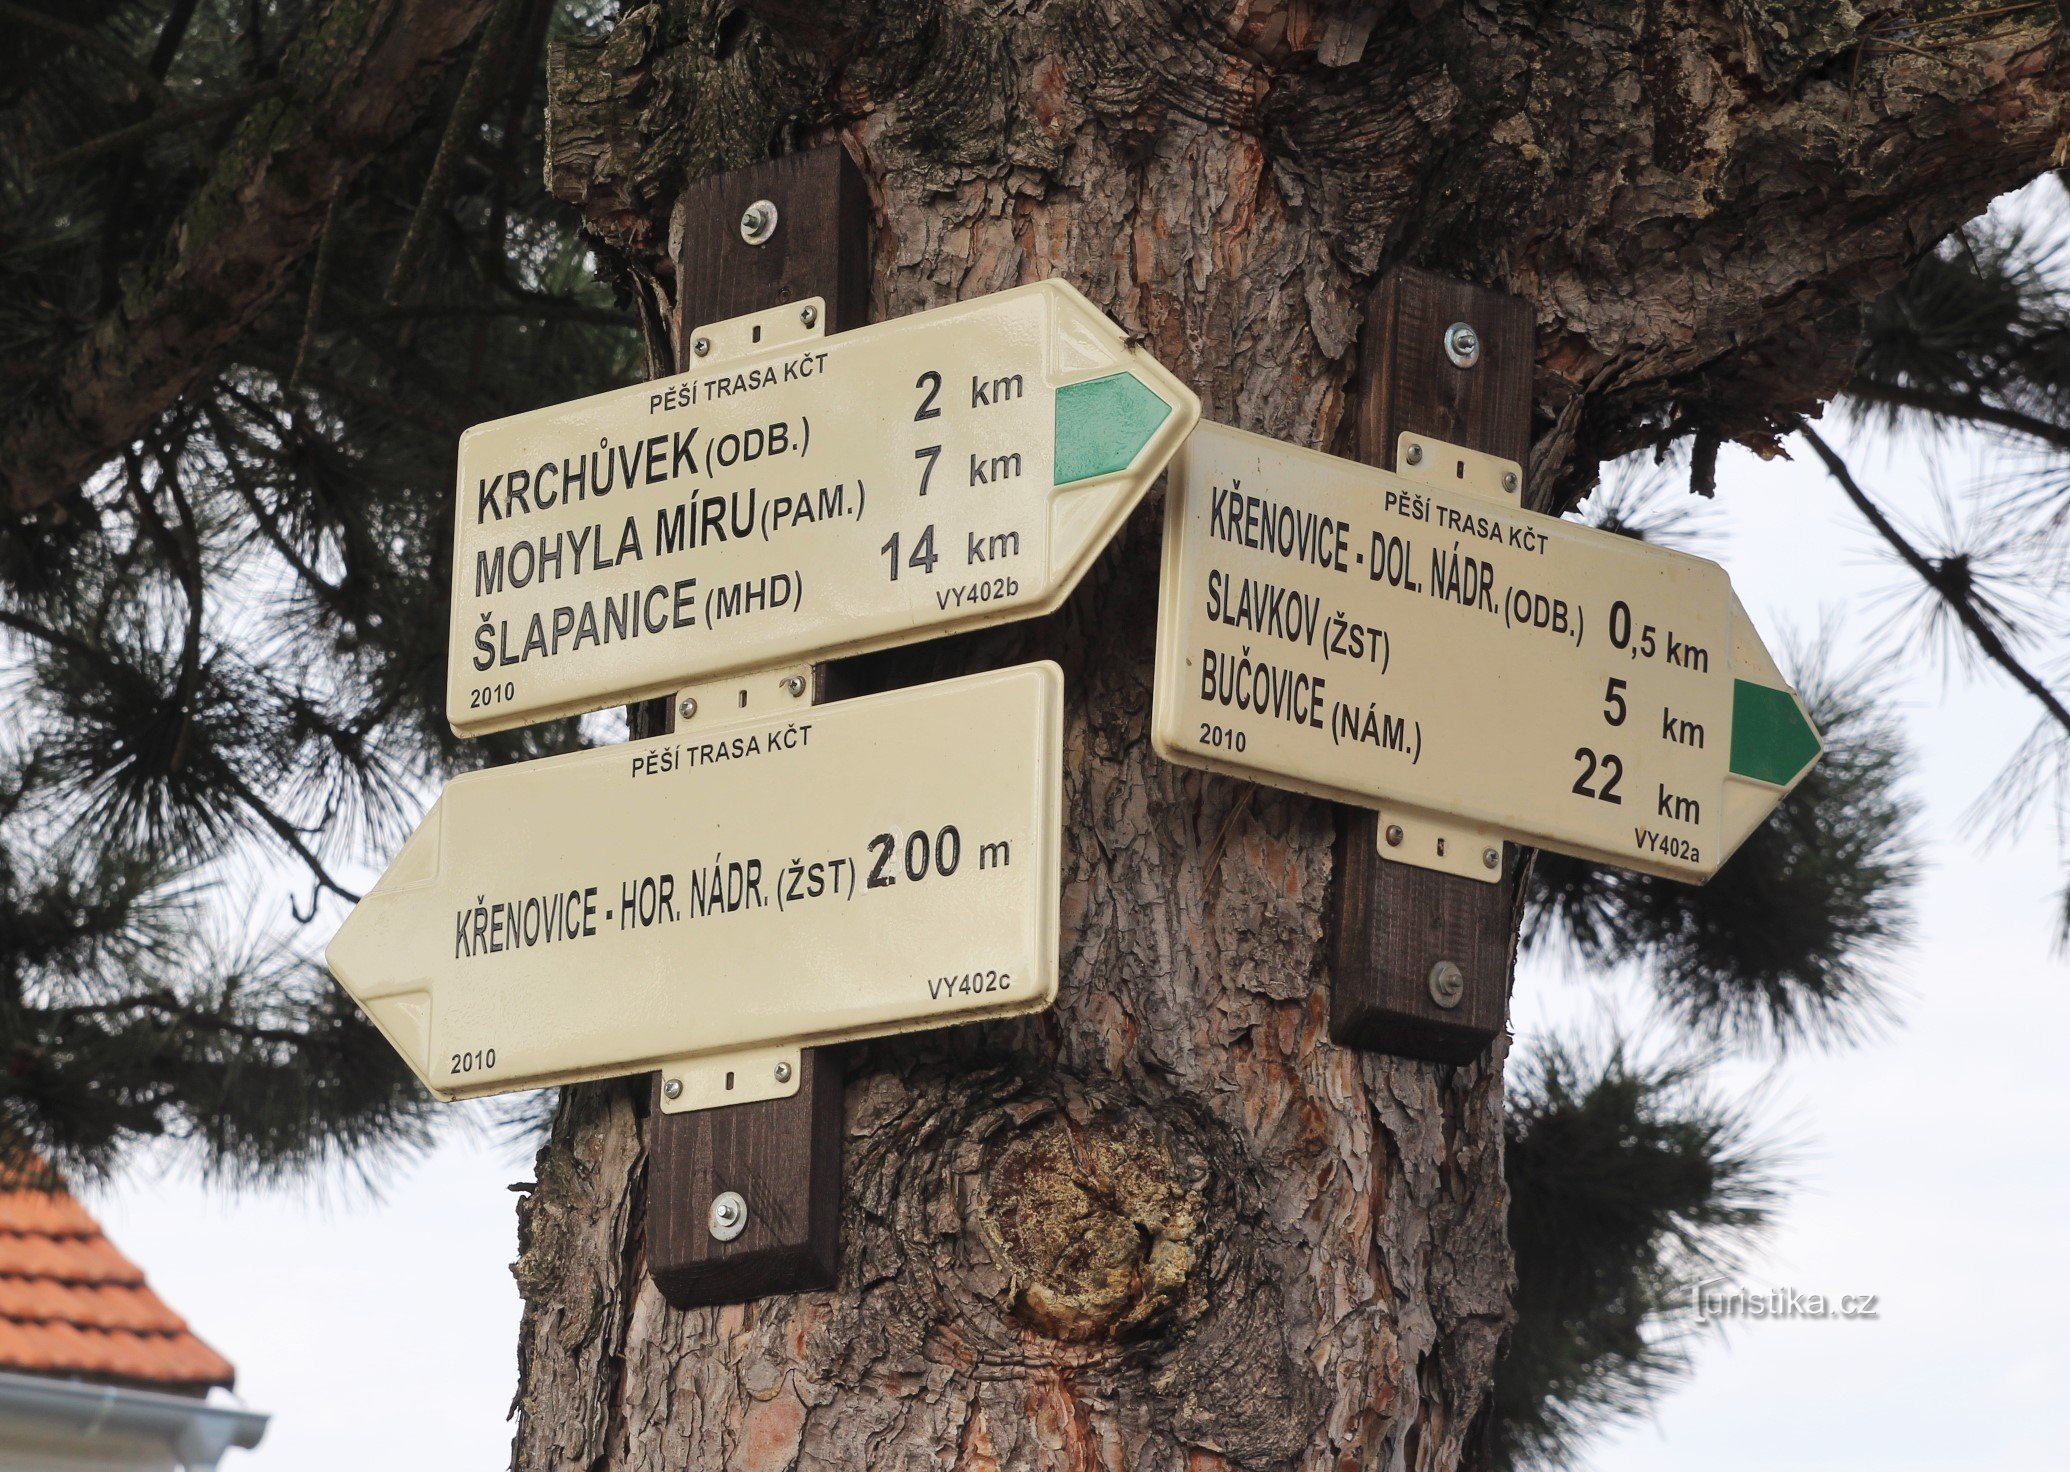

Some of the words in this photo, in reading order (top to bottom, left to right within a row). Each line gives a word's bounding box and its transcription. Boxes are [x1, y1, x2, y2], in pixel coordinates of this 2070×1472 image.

[650, 382, 697, 415] PĚŠÍ
[703, 366, 778, 401] TRASA
[784, 352, 829, 382] KČT
[913, 370, 942, 422] 2
[971, 374, 1023, 409] km
[477, 426, 700, 525] KRCHŮVEK
[705, 415, 810, 479] (ODB.)
[914, 444, 942, 497] 7
[969, 452, 1022, 487] km
[475, 515, 643, 598] MOHYLA
[655, 487, 756, 557] MÍRU
[761, 479, 866, 542] (PAM.)
[880, 524, 939, 582] 14
[967, 530, 1020, 565] km
[1384, 489, 1432, 523] PĚŠÍ
[1435, 504, 1504, 544] TRASA
[1508, 525, 1549, 555] KČT
[936, 576, 1019, 611] VY402b
[1209, 478, 1350, 574] KŘENOVICE
[1369, 530, 1422, 594] DOL.
[1430, 540, 1499, 615] NÁDR.
[1504, 585, 1584, 648] (ODB.)
[472, 577, 697, 672] ŠLAPANICE
[705, 570, 803, 631] (MHD)
[1206, 568, 1321, 647] SLAVKOV
[1322, 610, 1390, 676] (ŽST)
[1608, 600, 1657, 661] 0,5
[1665, 630, 1709, 674] km
[470, 681, 515, 709] 2010
[1200, 646, 1326, 730] BUČOVICE
[1331, 701, 1422, 766] (NÁM.)
[1603, 676, 1627, 727] 5
[1661, 706, 1705, 750] km
[631, 746, 679, 778] PĚŠÍ
[686, 735, 761, 767] TRASA
[767, 722, 813, 753] KČT
[1199, 722, 1247, 753] 2010
[1571, 746, 1624, 806] 22
[1657, 782, 1700, 826] km
[866, 824, 961, 890] 200
[979, 840, 1010, 870] m
[1634, 827, 1700, 864] VY402a
[455, 886, 598, 959] KŘENOVICE
[620, 873, 681, 931] HOR.
[690, 852, 768, 919] NÁDR.
[777, 857, 856, 912] (ŽST)
[927, 970, 1011, 1000] VY402c
[450, 1048, 496, 1075] 2010
